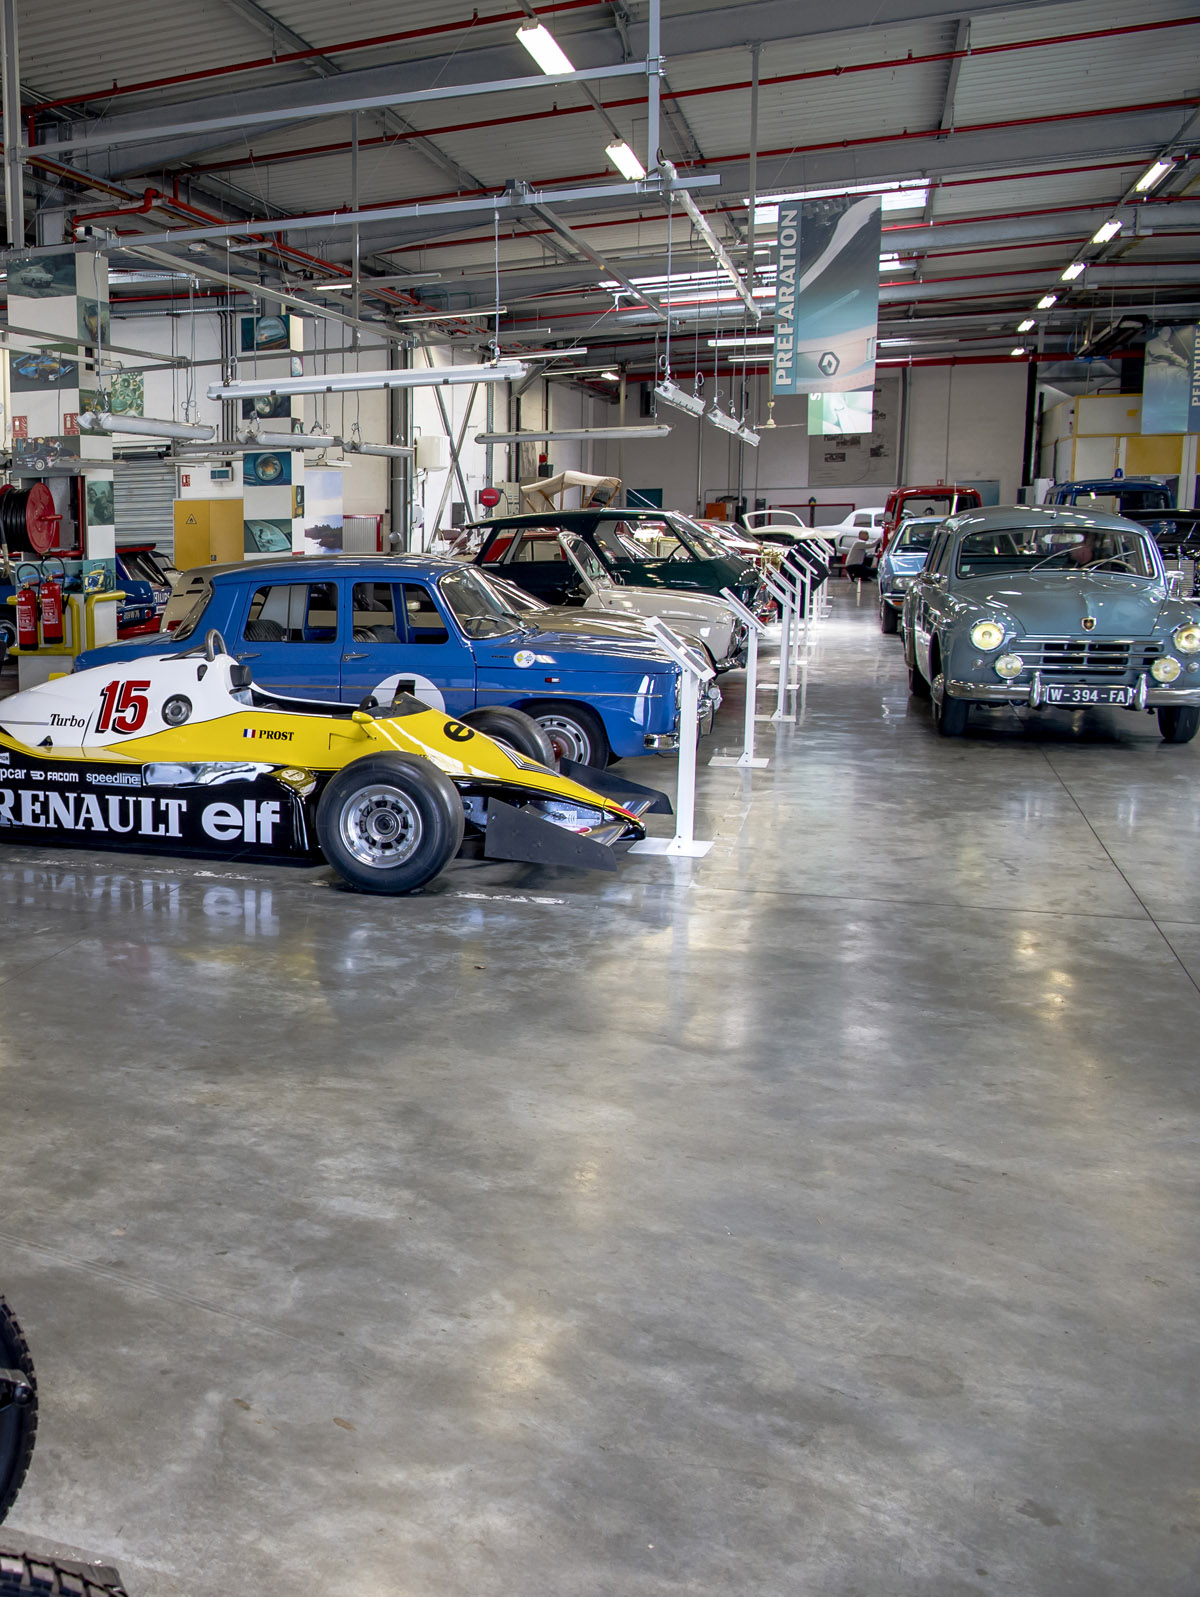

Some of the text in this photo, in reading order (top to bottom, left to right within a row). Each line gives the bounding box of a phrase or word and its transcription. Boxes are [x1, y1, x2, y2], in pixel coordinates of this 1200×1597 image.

[775, 209, 798, 386] PREPARATION
[1050, 688, 1126, 703] W-394-FA
[95, 680, 151, 735] 15
[49, 712, 86, 730] Turbo
[258, 729, 295, 742] PROST
[47, 771, 79, 782] FACOM
[86, 772, 139, 785] speedline
[201, 799, 281, 845] elf
